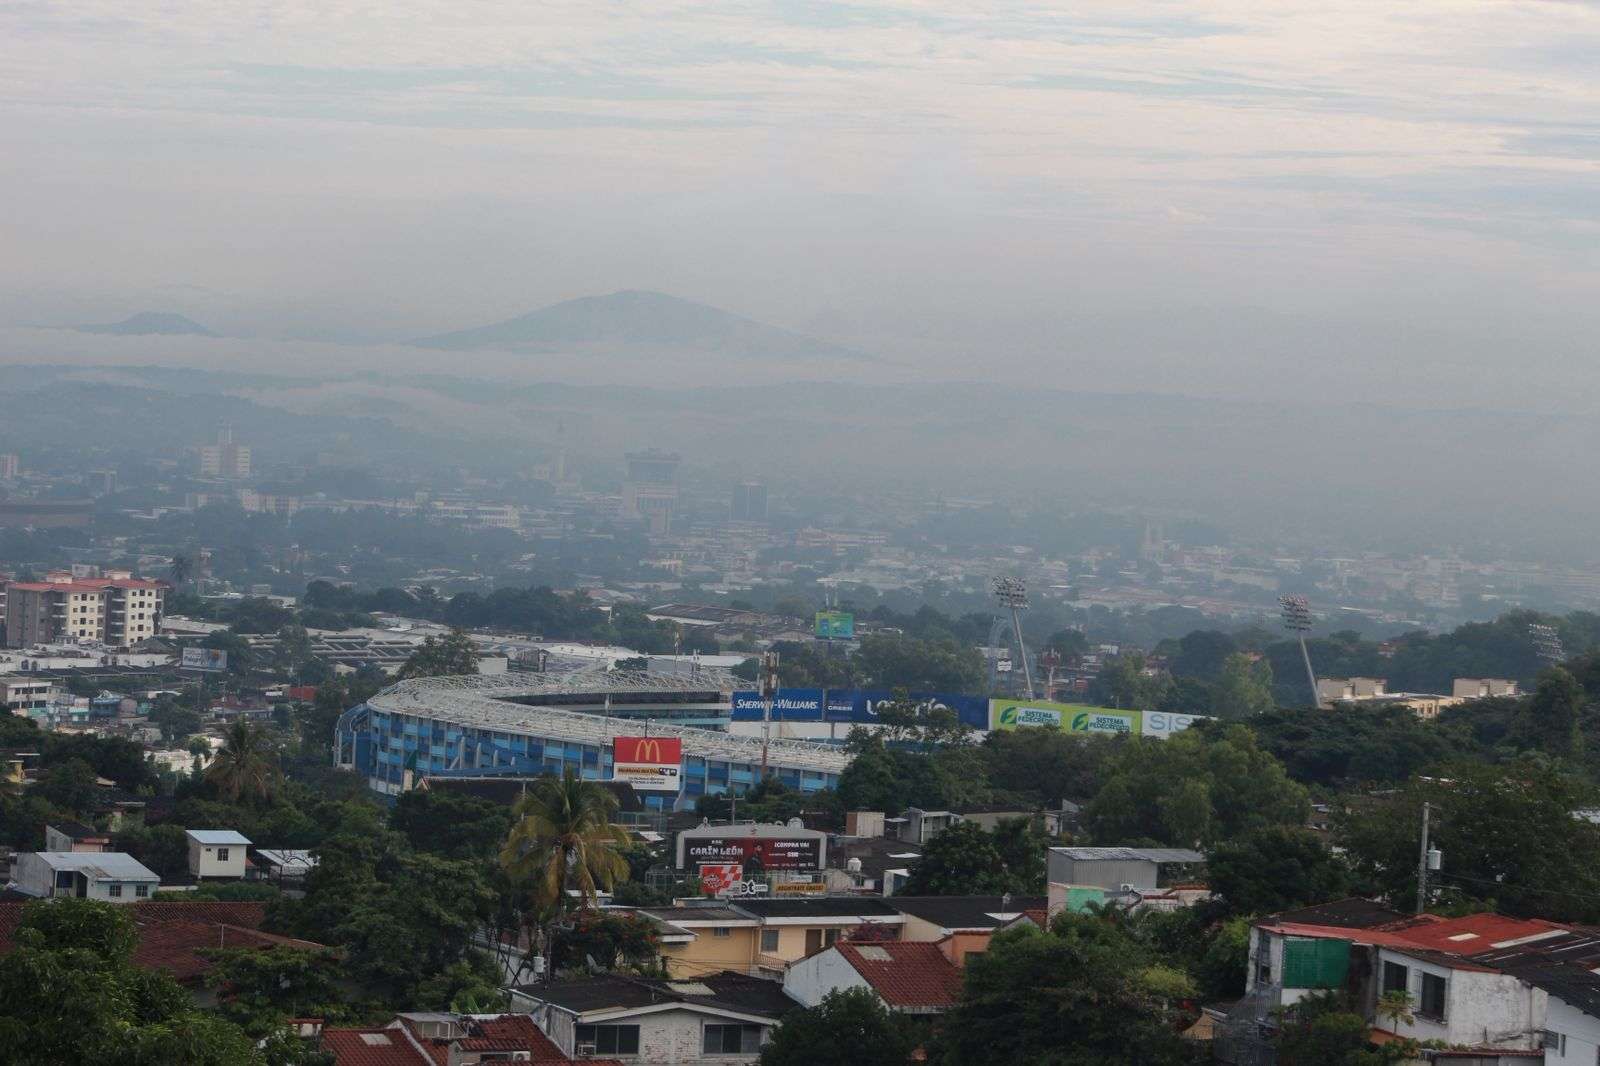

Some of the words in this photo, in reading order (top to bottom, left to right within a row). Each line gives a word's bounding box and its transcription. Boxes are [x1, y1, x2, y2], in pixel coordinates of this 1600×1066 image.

[1023, 710, 1053, 719] SISTEMA
[1096, 717, 1124, 725] SISTEMA
[690, 846, 719, 855] CARÍN
[720, 846, 744, 855] LEÓN
